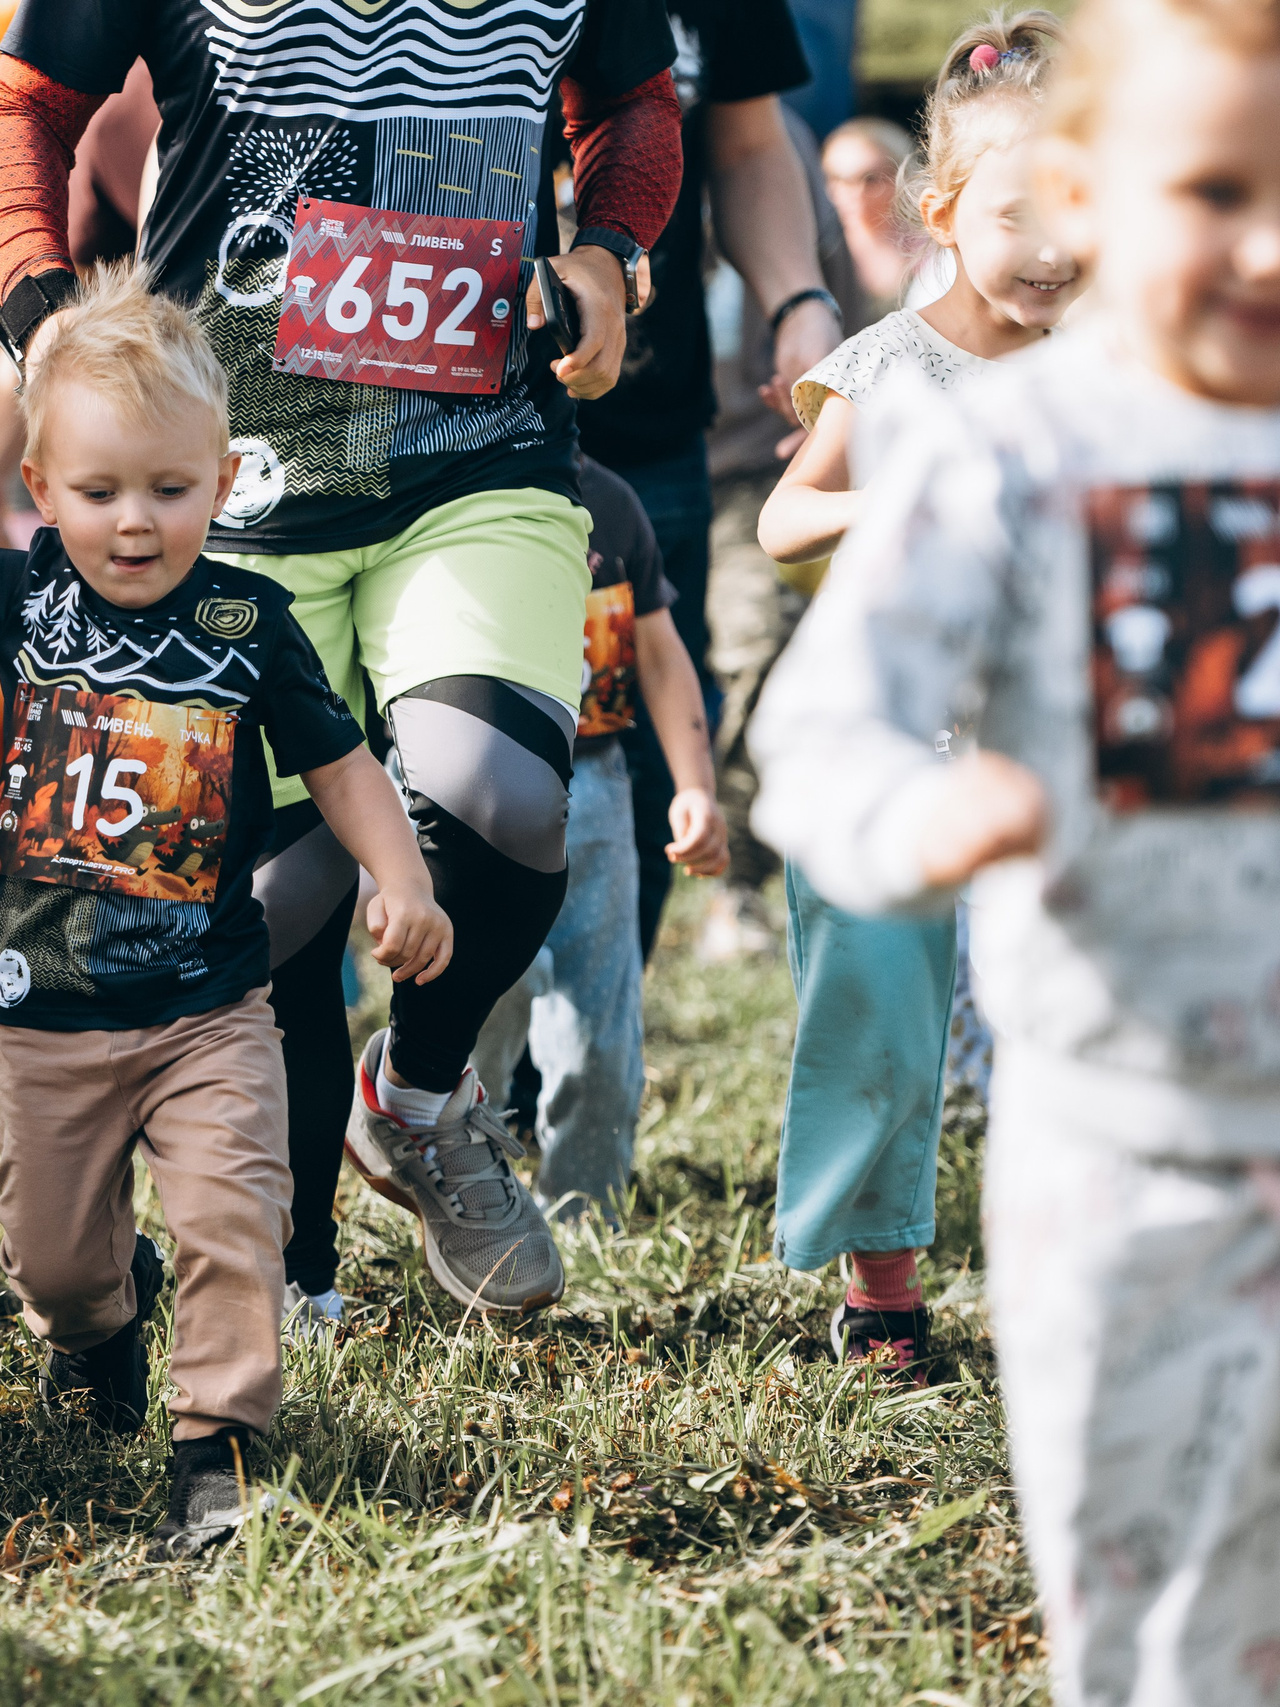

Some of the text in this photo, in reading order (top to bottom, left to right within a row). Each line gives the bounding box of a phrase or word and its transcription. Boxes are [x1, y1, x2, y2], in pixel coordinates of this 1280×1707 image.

[410, 234, 465, 251] ЛИВЕНЬ
[489, 238, 503, 256] S
[325, 255, 483, 347] 652
[300, 348, 324, 361] 12:15
[416, 365, 437, 373] PRO
[93, 715, 154, 738] ЛИВЕНЬ
[180, 728, 211, 744] ТУЧКА
[14, 741, 32, 753] 10:45
[66, 753, 147, 837] 15
[113, 865, 136, 875] PRO
